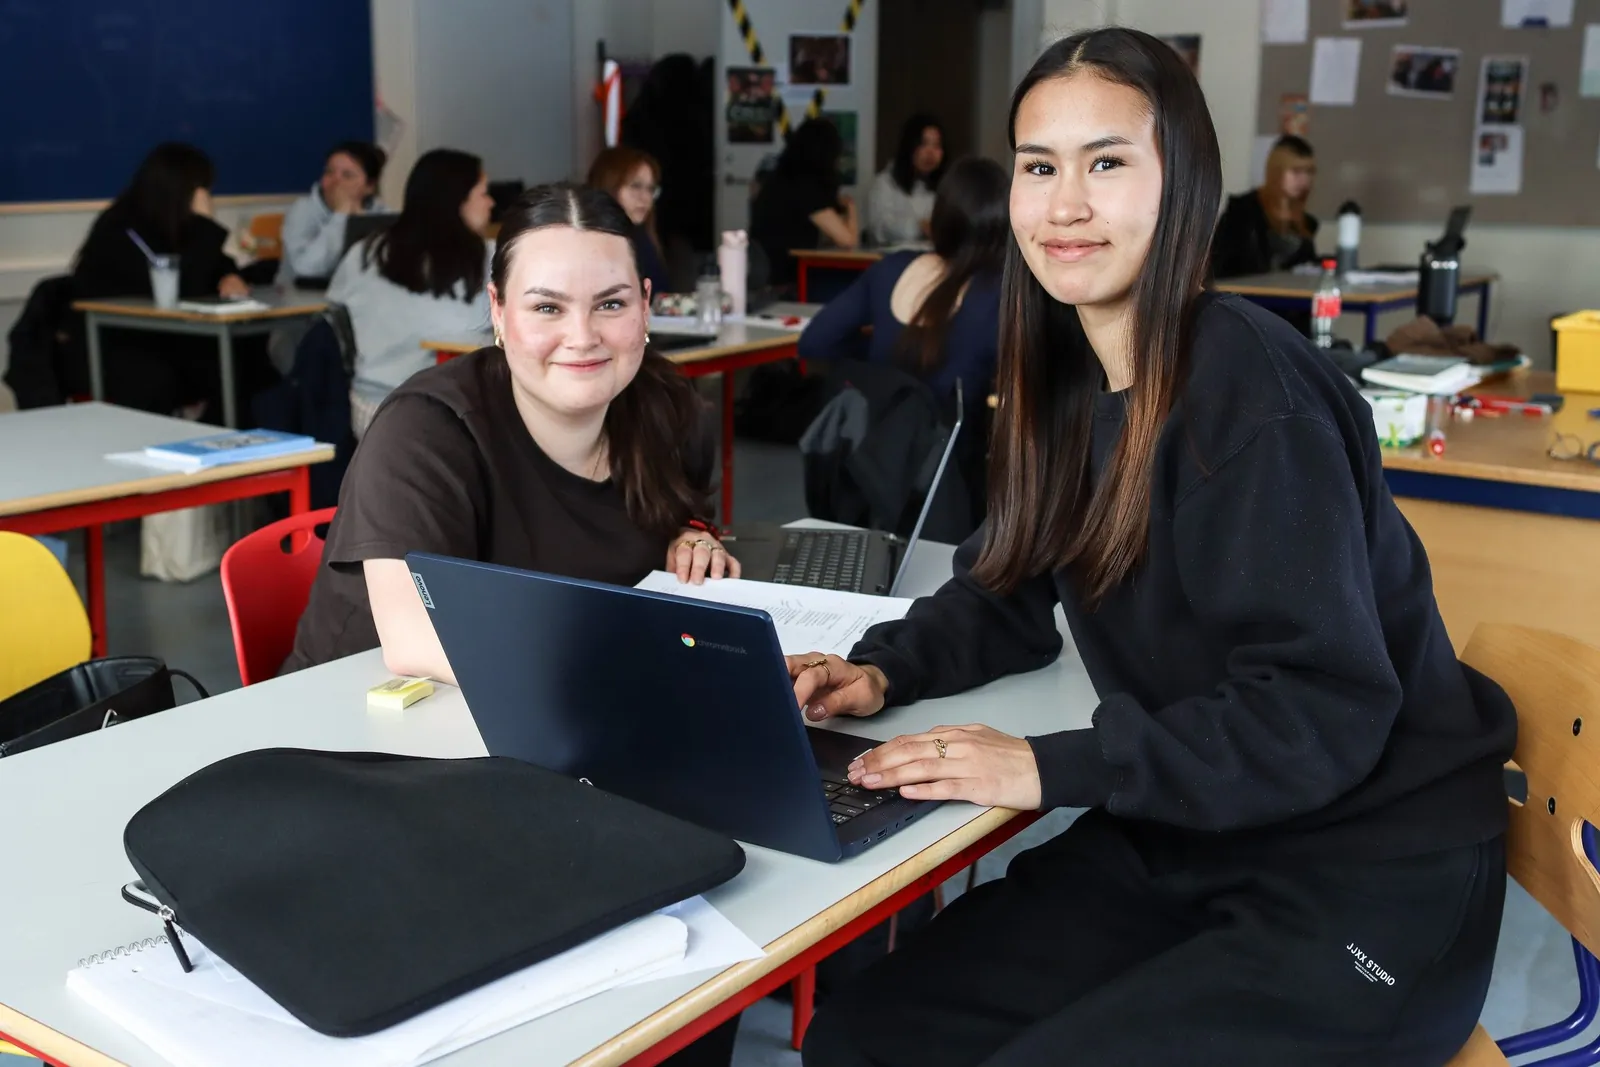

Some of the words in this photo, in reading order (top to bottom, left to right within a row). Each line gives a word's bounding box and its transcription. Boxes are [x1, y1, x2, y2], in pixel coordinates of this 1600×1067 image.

[415, 575, 432, 606] Lenovo
[1346, 943, 1367, 963] JJXX
[1366, 959, 1396, 986] STUDIO
